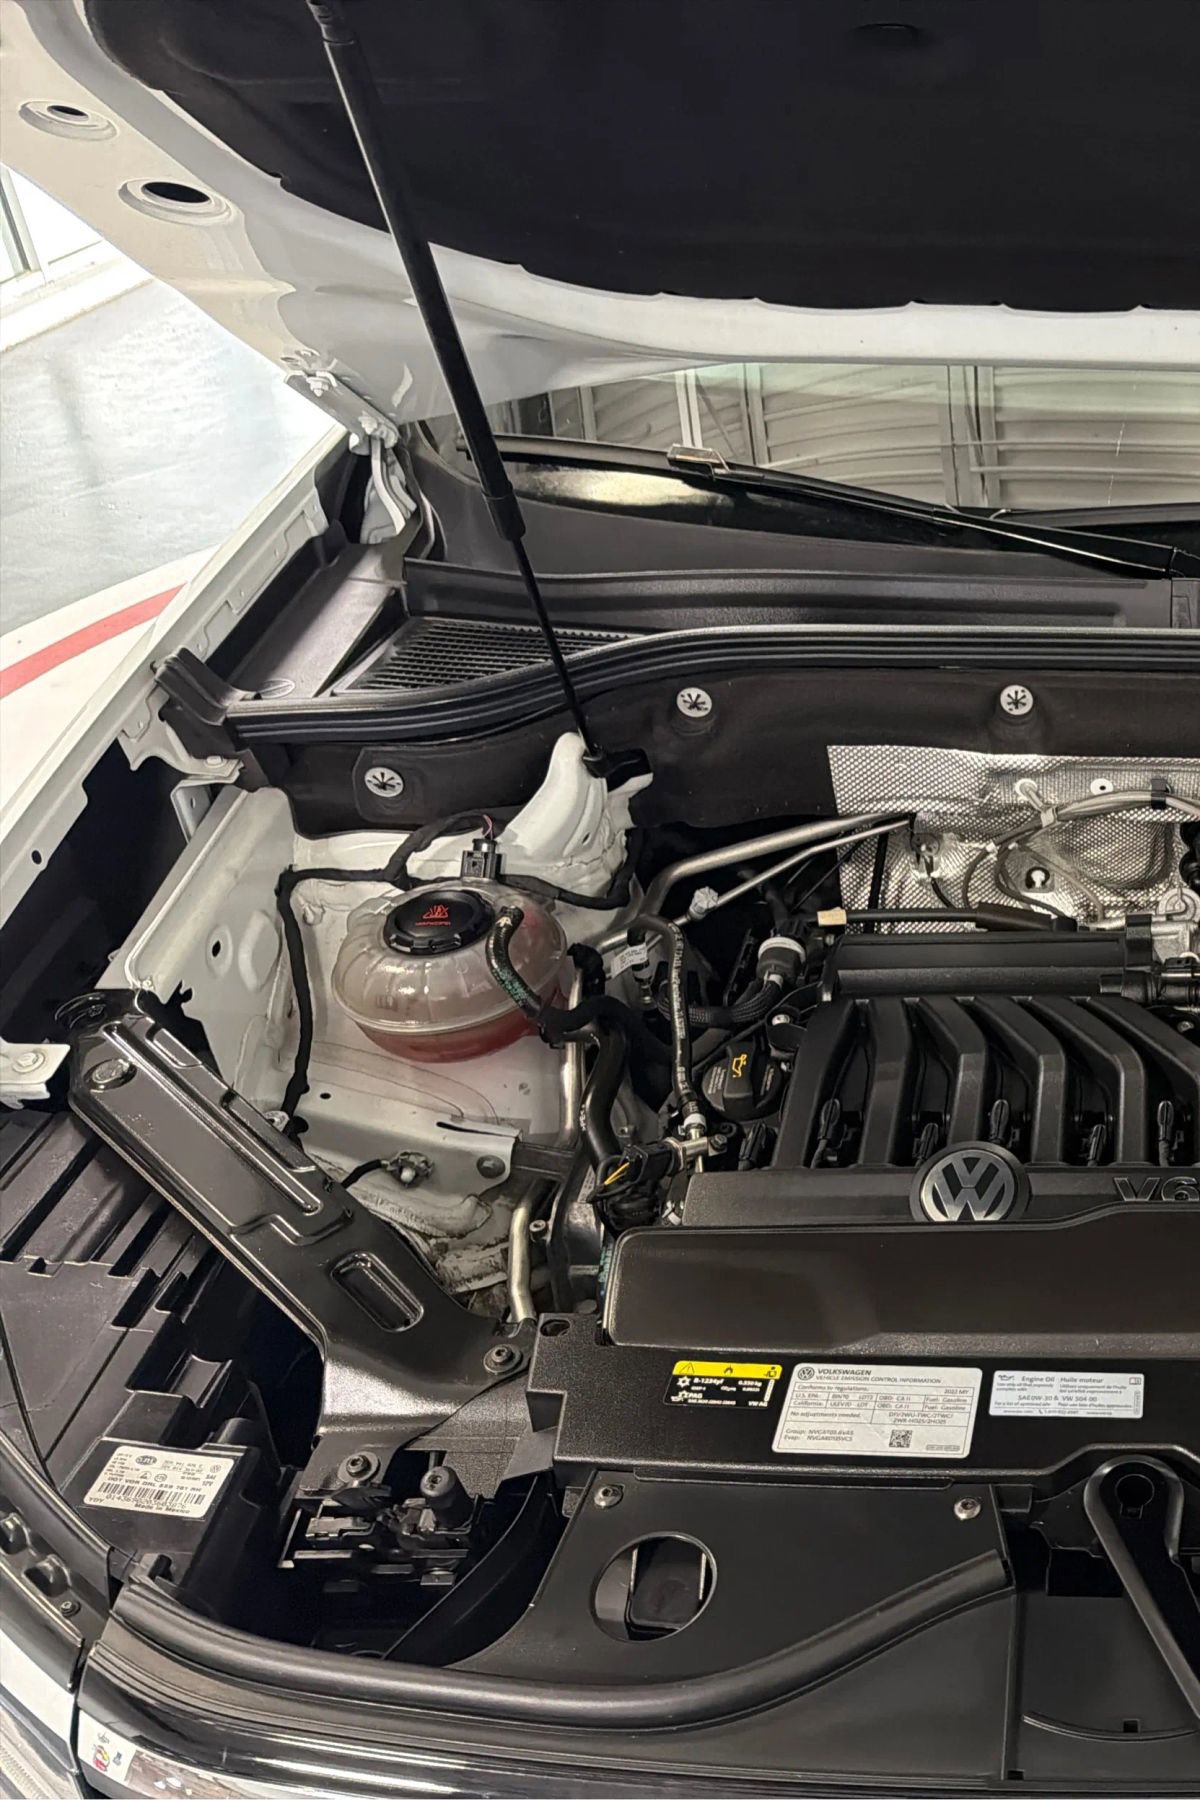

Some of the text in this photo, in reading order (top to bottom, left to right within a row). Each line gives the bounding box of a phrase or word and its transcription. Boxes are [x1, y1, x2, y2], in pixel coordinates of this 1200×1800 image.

[1113, 1176, 1200, 1201] V6
[816, 1368, 872, 1376] VOLKSWAGEN
[1021, 1375, 1044, 1384] Engine
